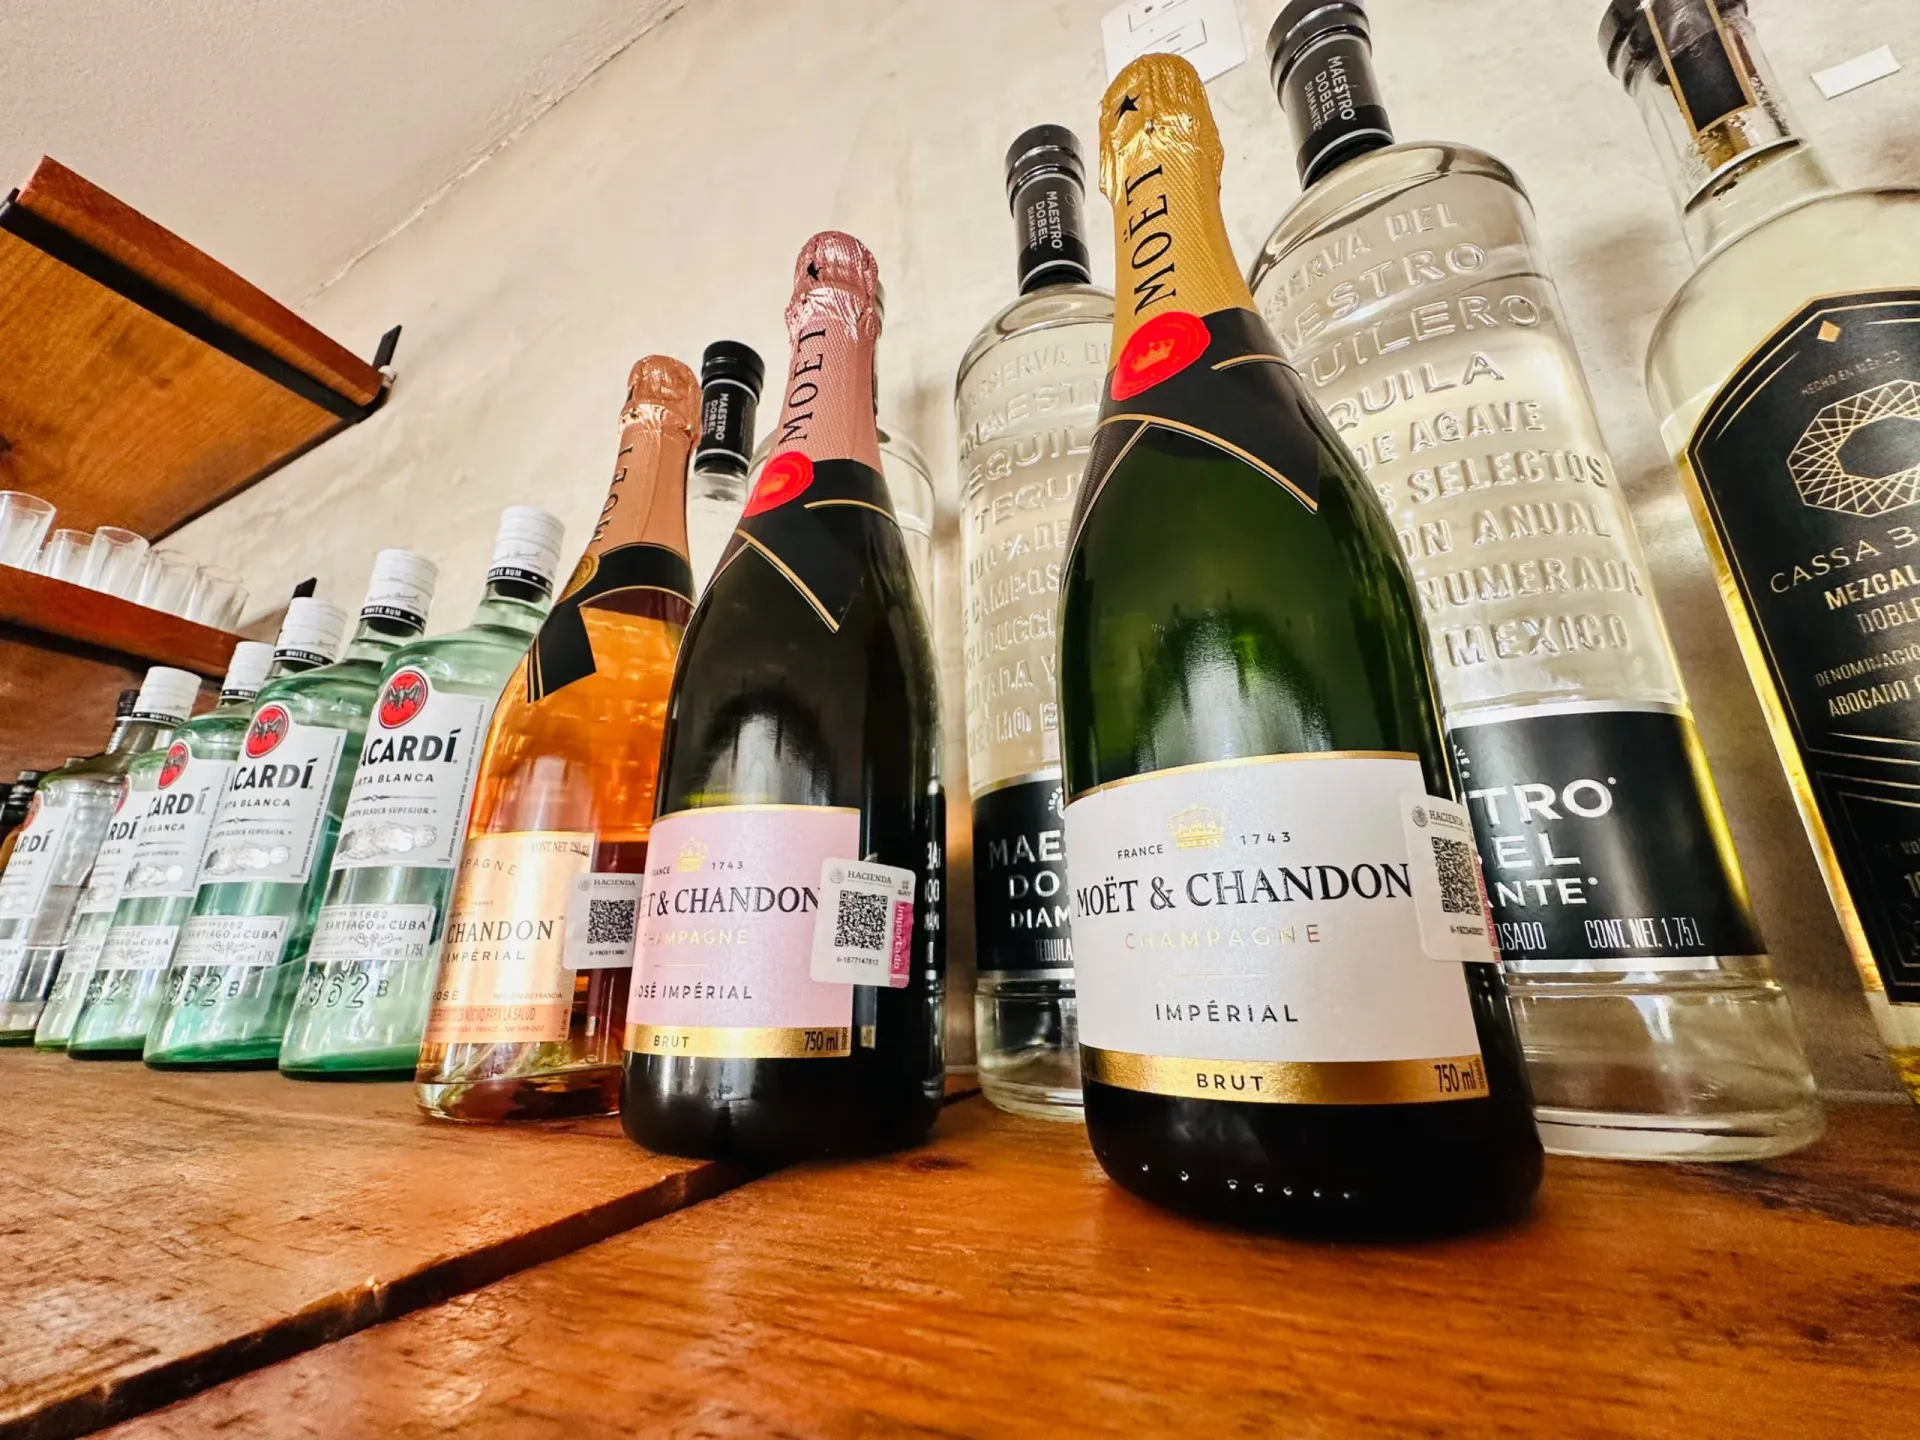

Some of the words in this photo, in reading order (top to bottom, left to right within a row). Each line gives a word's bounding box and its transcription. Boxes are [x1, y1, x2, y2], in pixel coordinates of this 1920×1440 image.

[1315, 70, 1336, 122] DOBEL
[1328, 55, 1357, 121] MAESTRO
[1304, 81, 1322, 130] DIAMANTE
[1035, 200, 1049, 245] DOBEL
[1046, 191, 1063, 250] MAESTRO
[1386, 203, 1459, 242] DEL
[1123, 164, 1177, 317] MOËT
[715, 393, 729, 441] MAESTRO
[1410, 401, 1546, 453] AGAVE
[1407, 450, 1608, 504] SELECTOS
[1473, 502, 1612, 546] ANUAL
[1770, 539, 1884, 594] CASSA
[1415, 556, 1644, 614] NUMERADA
[1445, 613, 1631, 668] MEXICO
[1828, 679, 1910, 718] ABOCADO
[377, 772, 434, 784] BLANCA
[240, 798, 291, 808] BLANCA
[1428, 809, 1465, 828] HACIENDA
[988, 829, 1067, 870] MAE
[1117, 843, 1165, 860] FRANCE
[1239, 831, 1293, 846] 1743
[711, 860, 744, 871] 1743
[847, 869, 893, 886] HACIENDA
[594, 879, 636, 887] HACIENDA
[1076, 875, 1140, 919] MOËT
[1149, 876, 1178, 911] &
[1185, 863, 1413, 908] CHANDON
[656, 890, 669, 917] &
[674, 886, 820, 914] CHANDON
[243, 930, 279, 940] CUBA
[389, 919, 427, 931] CUBA
[447, 920, 555, 945] CHANDON
[892, 904, 906, 970] Importado
[1124, 923, 1322, 951] CHAMPAGNE
[1584, 919, 1631, 949] CONT.
[1629, 917, 1662, 949] NET.
[662, 982, 753, 1001] IMPÉRIAL
[1155, 999, 1300, 1023] IMPÉRIAL
[653, 1035, 690, 1048] BRUT
[804, 1031, 826, 1052] 750
[826, 1031, 839, 1051] ml
[1196, 1072, 1265, 1092] BRUT
[1434, 1062, 1460, 1094] 750
[1460, 1061, 1477, 1092] ml
